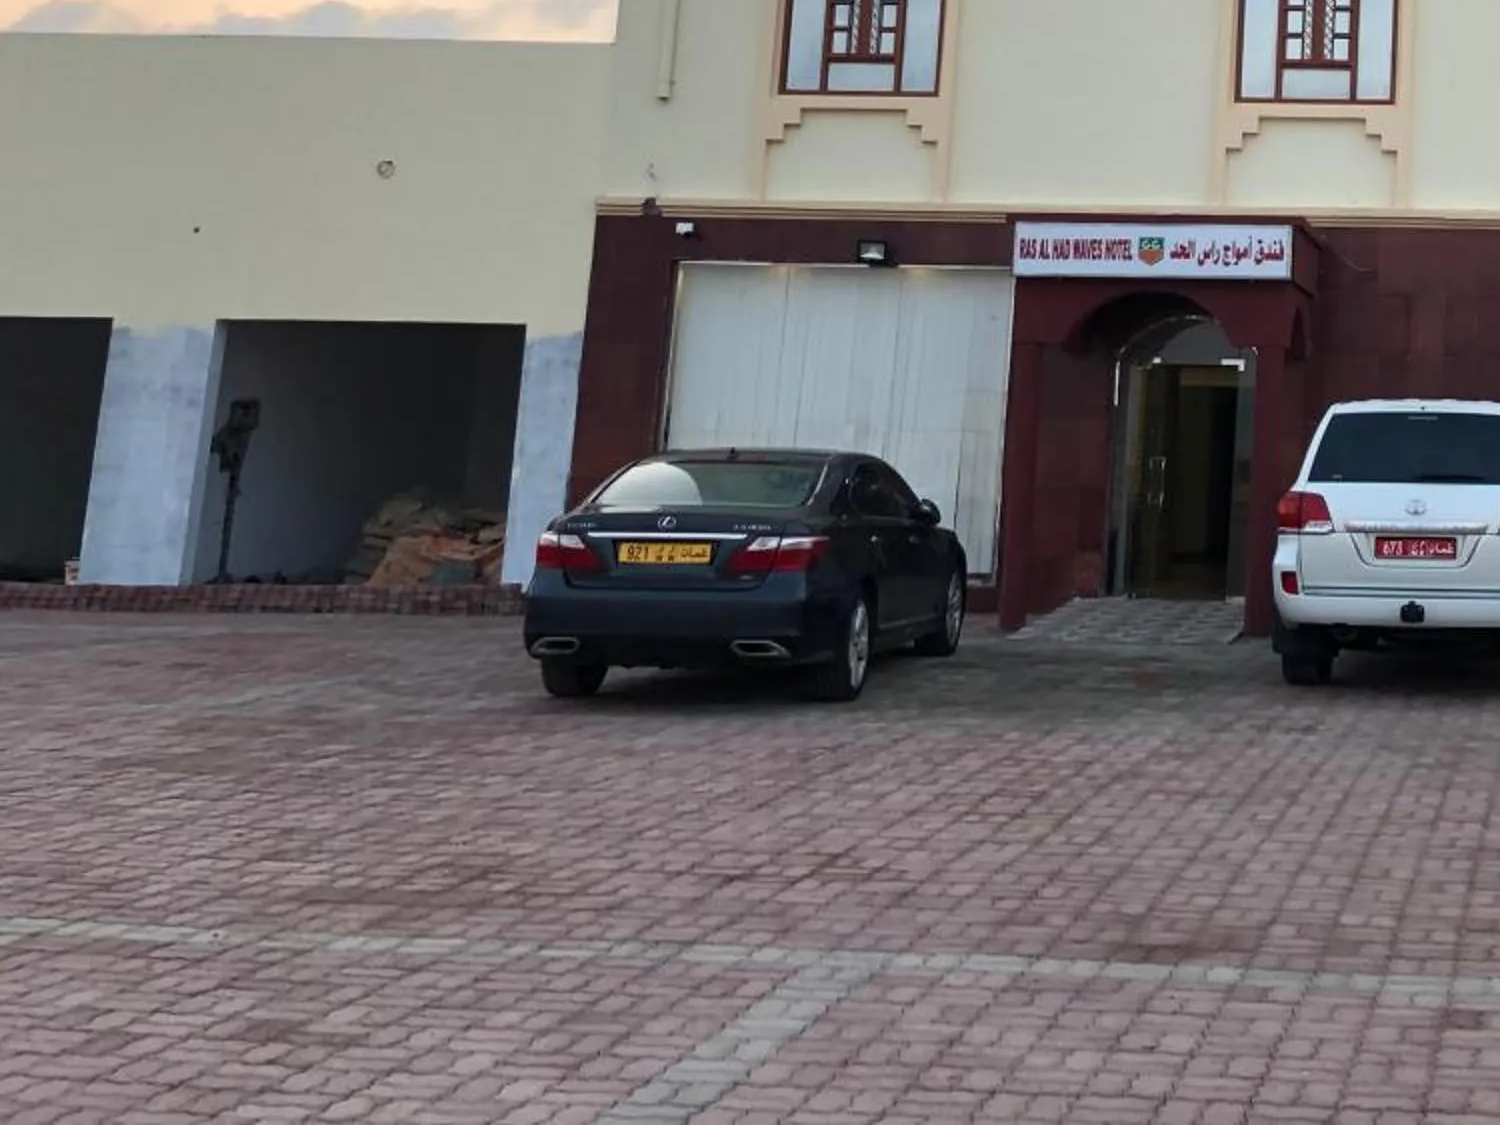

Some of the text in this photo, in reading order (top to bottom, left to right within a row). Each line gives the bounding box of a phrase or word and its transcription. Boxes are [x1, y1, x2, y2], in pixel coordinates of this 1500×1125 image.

[1019, 238, 1133, 261] RAS AL HAD WAVES HOTEL
[1169, 238, 1196, 260] الحد
[1254, 238, 1285, 265] فندق
[626, 545, 649, 560] 921
